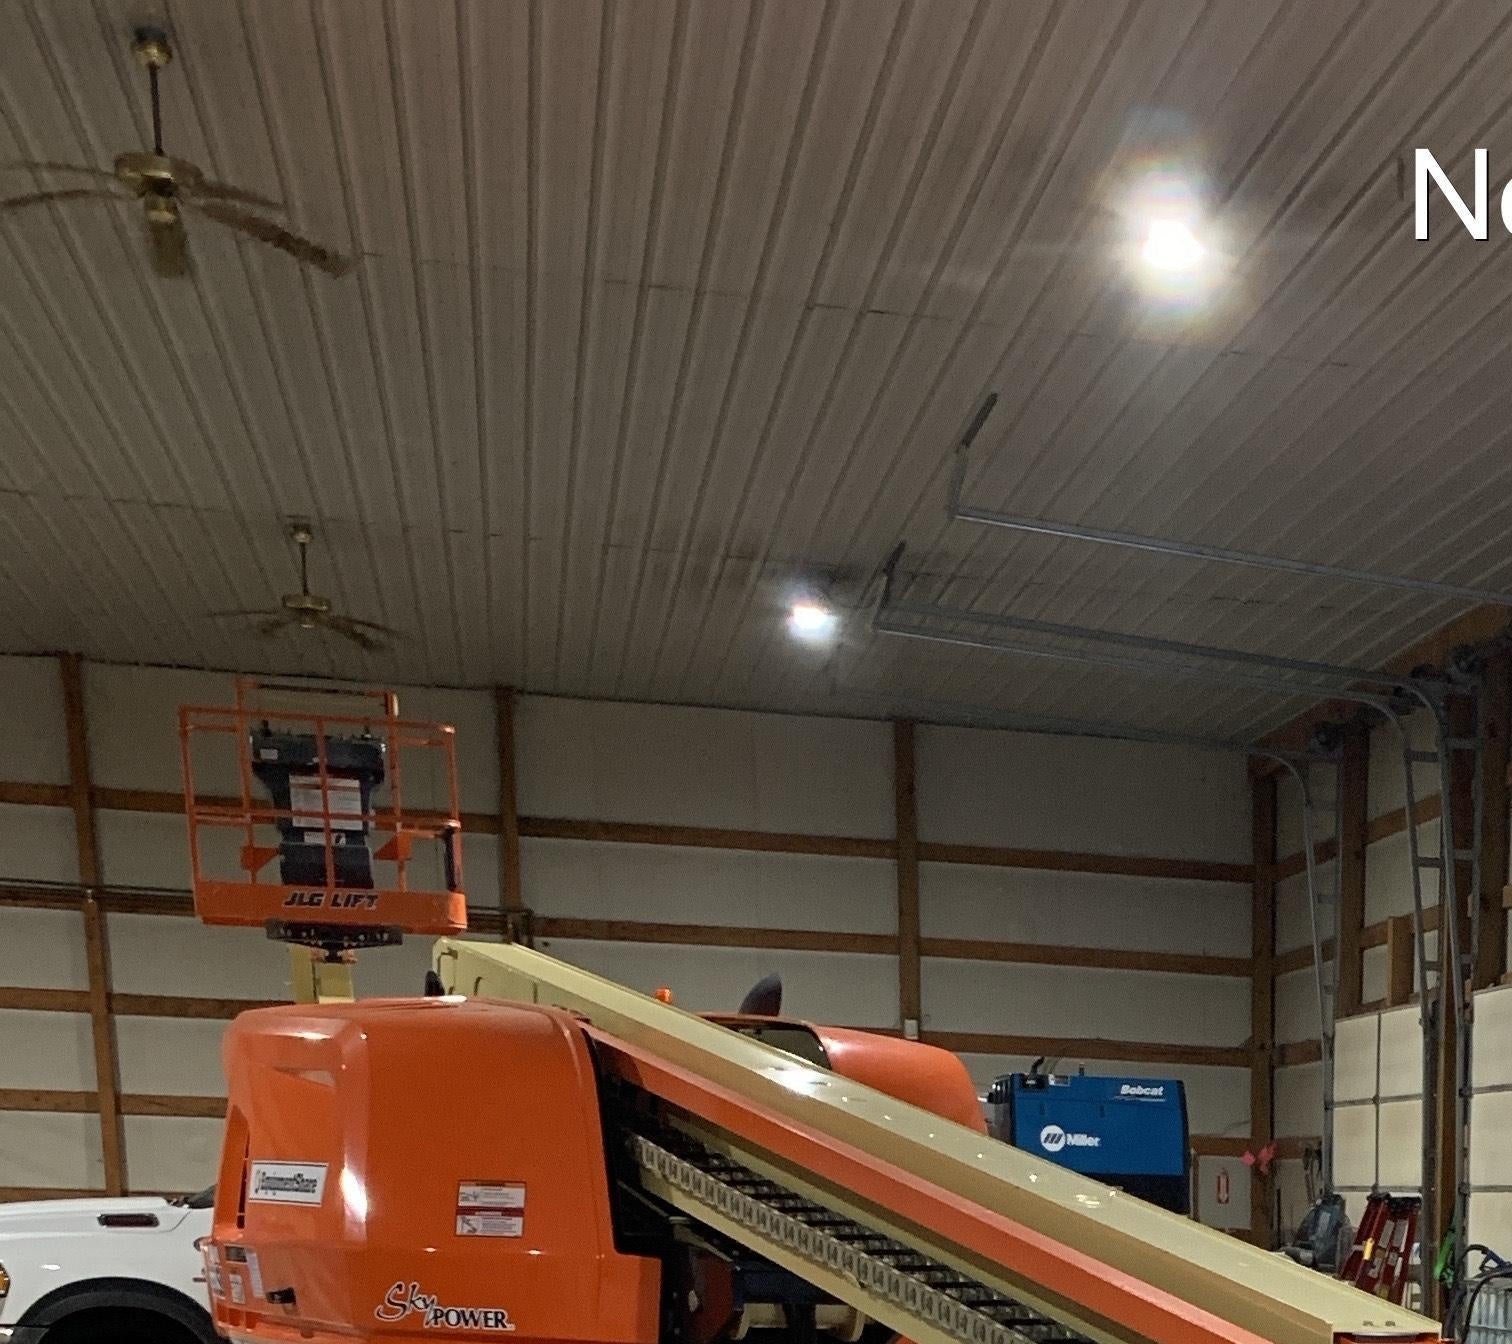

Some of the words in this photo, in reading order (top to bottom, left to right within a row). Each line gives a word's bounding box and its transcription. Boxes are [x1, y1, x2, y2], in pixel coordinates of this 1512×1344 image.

[284, 892, 325, 907] JLG
[330, 893, 379, 908] LIFT
[1120, 1084, 1164, 1096] Bobcat
[1065, 1133, 1101, 1147] Miller
[376, 1282, 437, 1327] Sky
[431, 1307, 507, 1329] POWER
